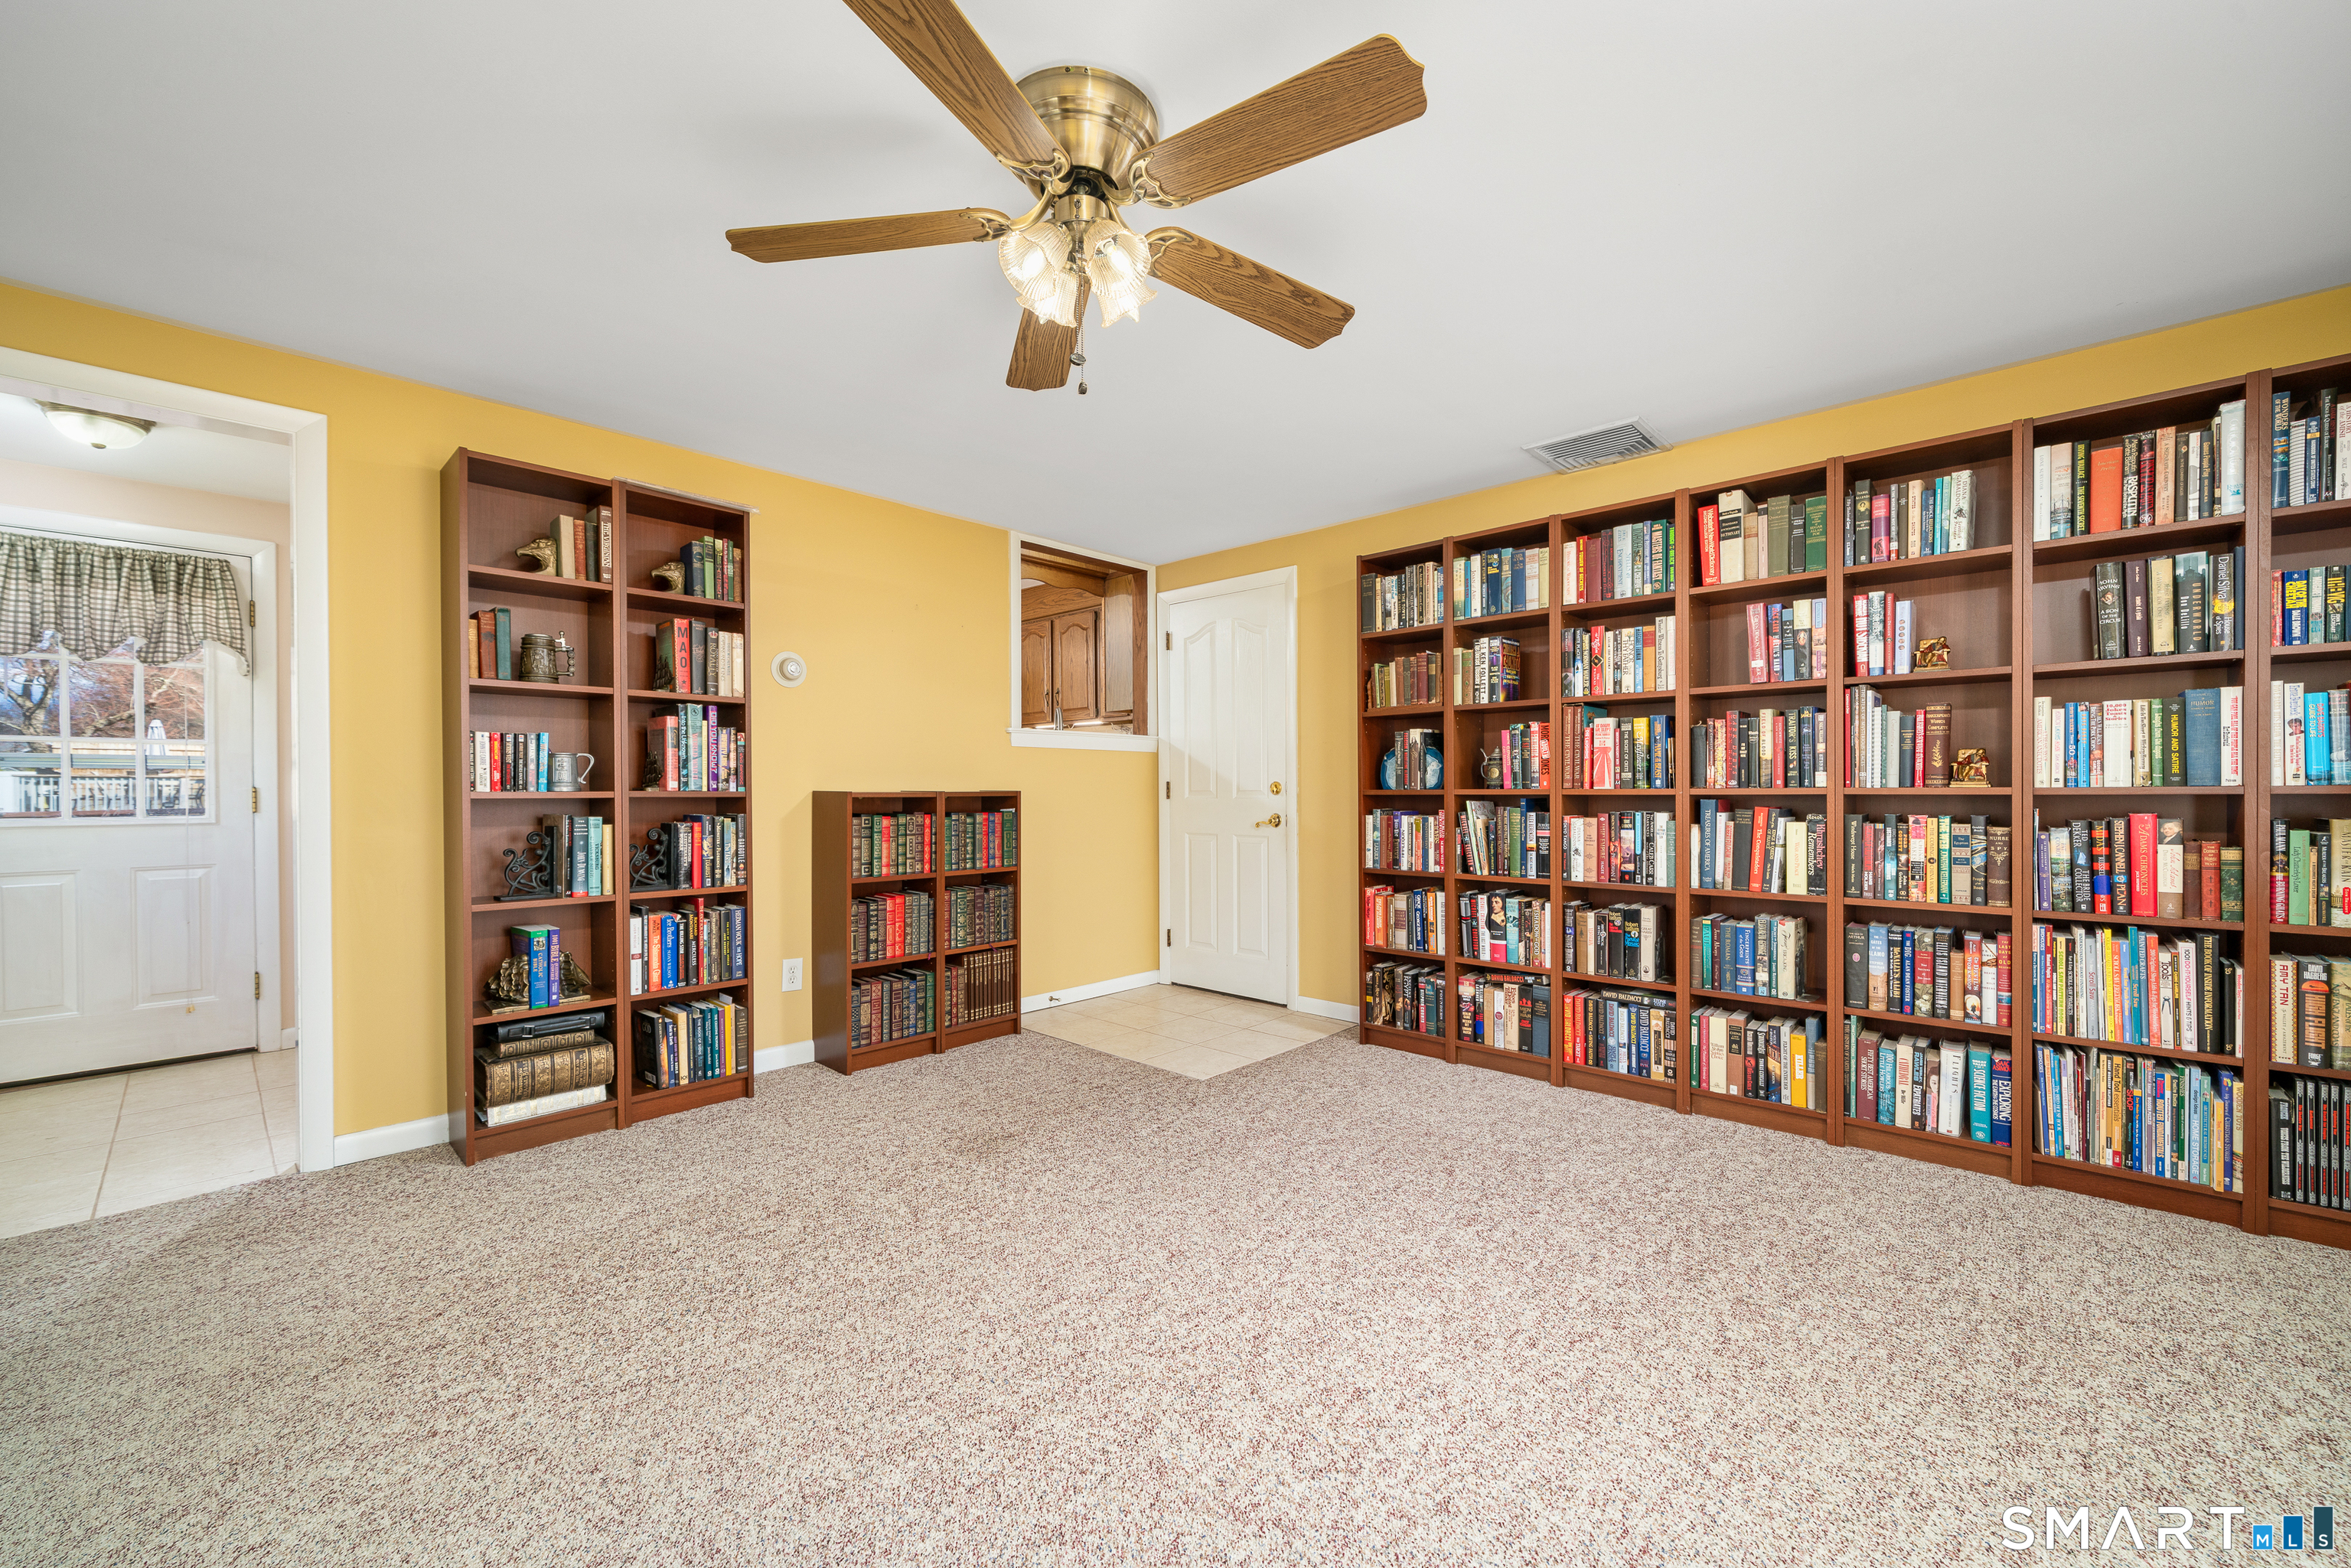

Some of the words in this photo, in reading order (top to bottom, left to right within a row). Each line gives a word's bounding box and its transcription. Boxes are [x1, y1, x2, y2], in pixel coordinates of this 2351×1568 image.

[2128, 475, 2138, 517] RASPUTIN
[602, 532, 611, 567] VIRGINIAN
[1652, 530, 1662, 553] MASTERS
[1652, 560, 1662, 580] FANTASY
[2218, 557, 2229, 579] Daniel
[2098, 583, 2120, 592] IRVING
[2100, 578, 2118, 586] JOHN
[2218, 580, 2230, 599] Silva
[2296, 580, 2307, 591] DAY
[2180, 596, 2190, 607] Don
[2286, 581, 2296, 608] CHEETAH
[2296, 599, 2307, 608] THE
[2180, 608, 2190, 630] DeLillo
[2192, 582, 2202, 641] UNDERWORLD
[2292, 610, 2300, 621] DALE
[2224, 616, 2232, 634] House
[2292, 621, 2300, 637] BROWN
[678, 627, 688, 668] MAO
[1635, 732, 1644, 771] Mayflower
[1789, 746, 1798, 760] KISS
[1705, 836, 1710, 846] OF
[2072, 823, 2082, 847] DEKKER
[2115, 820, 2124, 843] STEPHEN
[2139, 825, 2150, 853] ADAMS
[2275, 824, 2286, 836] PAUL
[1808, 833, 1817, 875] Remembers
[1817, 824, 1826, 869] Khrushchev
[2275, 837, 2286, 852] MANN
[2342, 832, 2351, 860] MASTER
[1753, 839, 1762, 875] Conquistadors
[2115, 848, 2125, 873] CANNELL
[577, 863, 586, 882] DUNNING
[2140, 855, 2148, 895] CHRONICLES
[2342, 865, 2351, 882] RAIN
[2075, 868, 2083, 902] COLLECTOR
[2117, 884, 2127, 905] PLAN
[2276, 882, 2285, 902] BURNING
[2276, 904, 2285, 918] GHATS
[1936, 942, 1948, 956] ELLIS
[1935, 957, 1948, 976] ISLAND
[2304, 971, 2327, 980] HAGBERG
[2308, 964, 2323, 973] DAVID
[1619, 994, 1642, 1002] BALDACCI
[1935, 977, 1948, 1008] INTERVIEWS
[2204, 993, 2212, 1030] INFORMATION
[2304, 993, 2326, 1016] HIGH
[1640, 1009, 1649, 1026] DAVID
[1640, 1026, 1649, 1052] BALDACCI
[2304, 1016, 2326, 1049] FLIGHT
[1952, 1055, 1961, 1094] FLIGHTS
[1974, 1068, 1985, 1090] SCIENCE
[1912, 1084, 1922, 1116] EXPATRIATES
[1974, 1090, 1986, 1112] FICTION
[1999, 1080, 2011, 1121] EXPLORING
